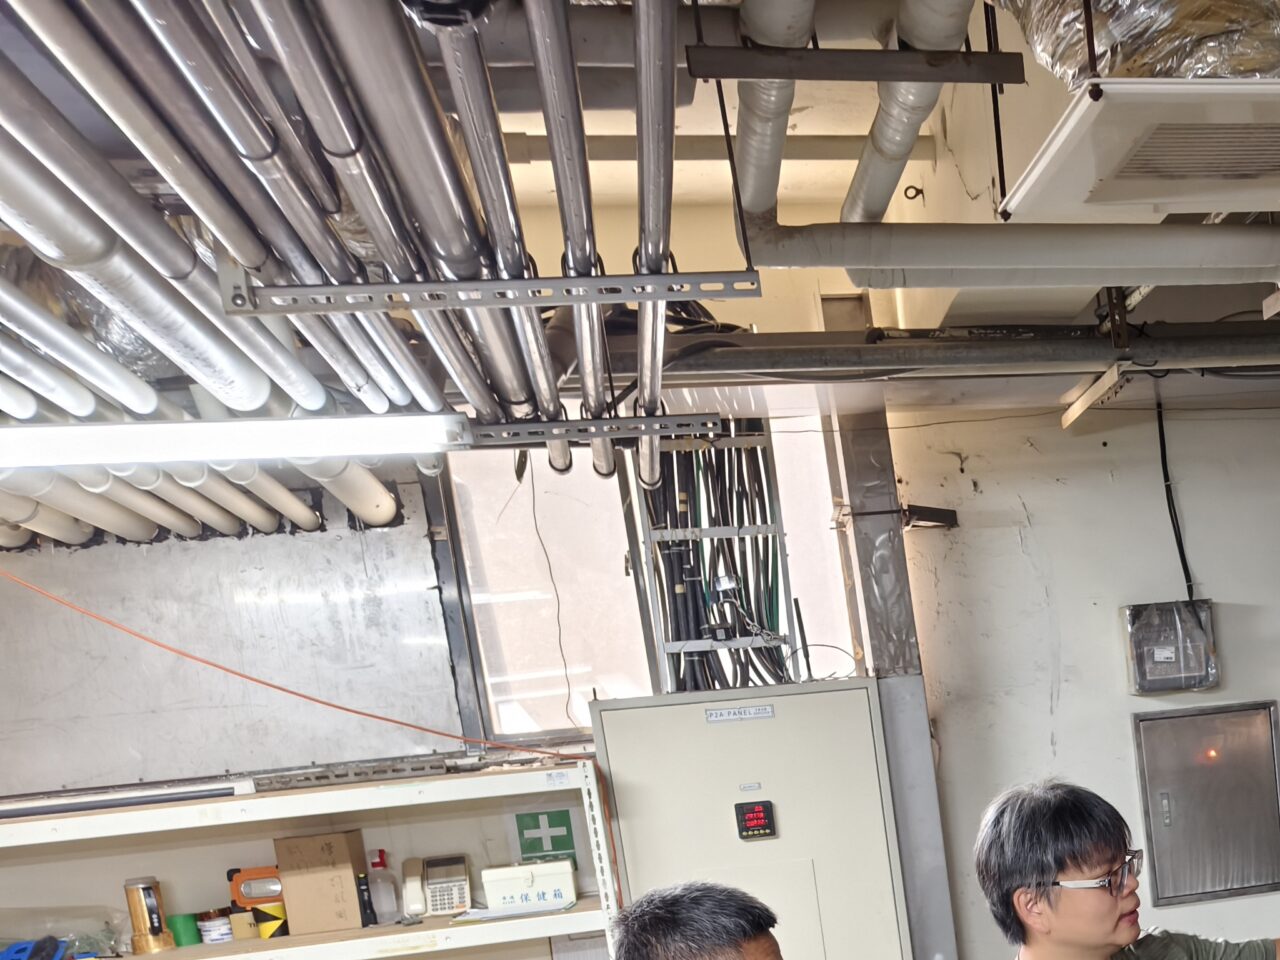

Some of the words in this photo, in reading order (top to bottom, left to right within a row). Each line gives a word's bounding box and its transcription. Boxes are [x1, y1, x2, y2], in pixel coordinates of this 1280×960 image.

[727, 709, 753, 717] PANEL
[520, 888, 564, 903] 保健箱
